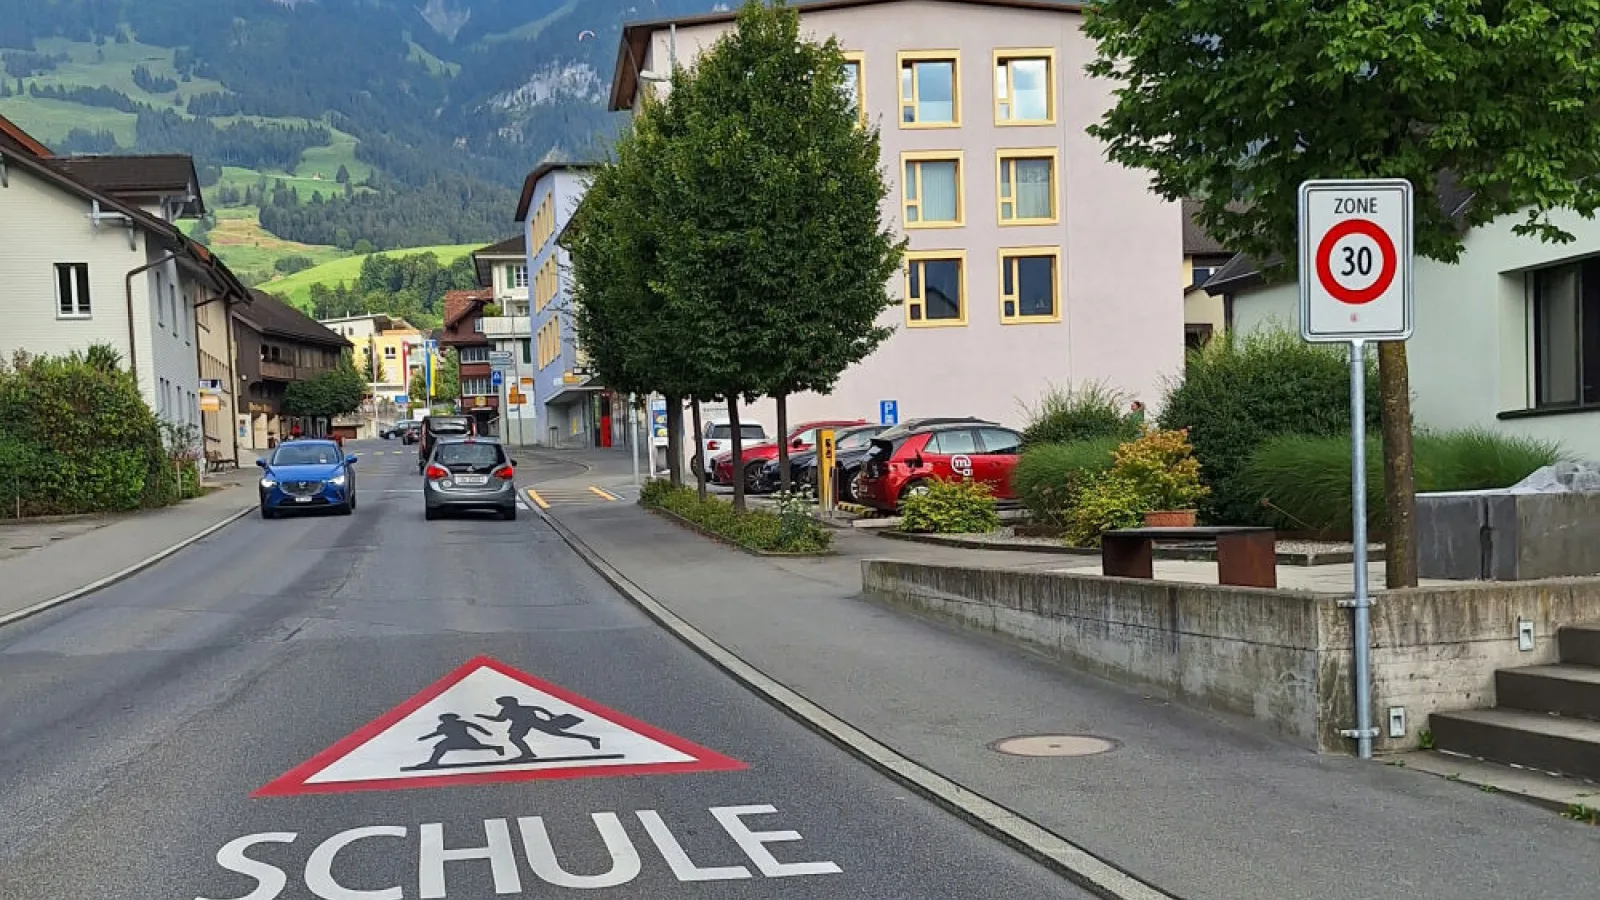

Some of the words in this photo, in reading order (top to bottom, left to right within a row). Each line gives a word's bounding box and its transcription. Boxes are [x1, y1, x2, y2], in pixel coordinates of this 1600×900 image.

[1333, 197, 1378, 214] ZONE
[1340, 246, 1372, 277] 30
[195, 804, 842, 900] SCHULE
